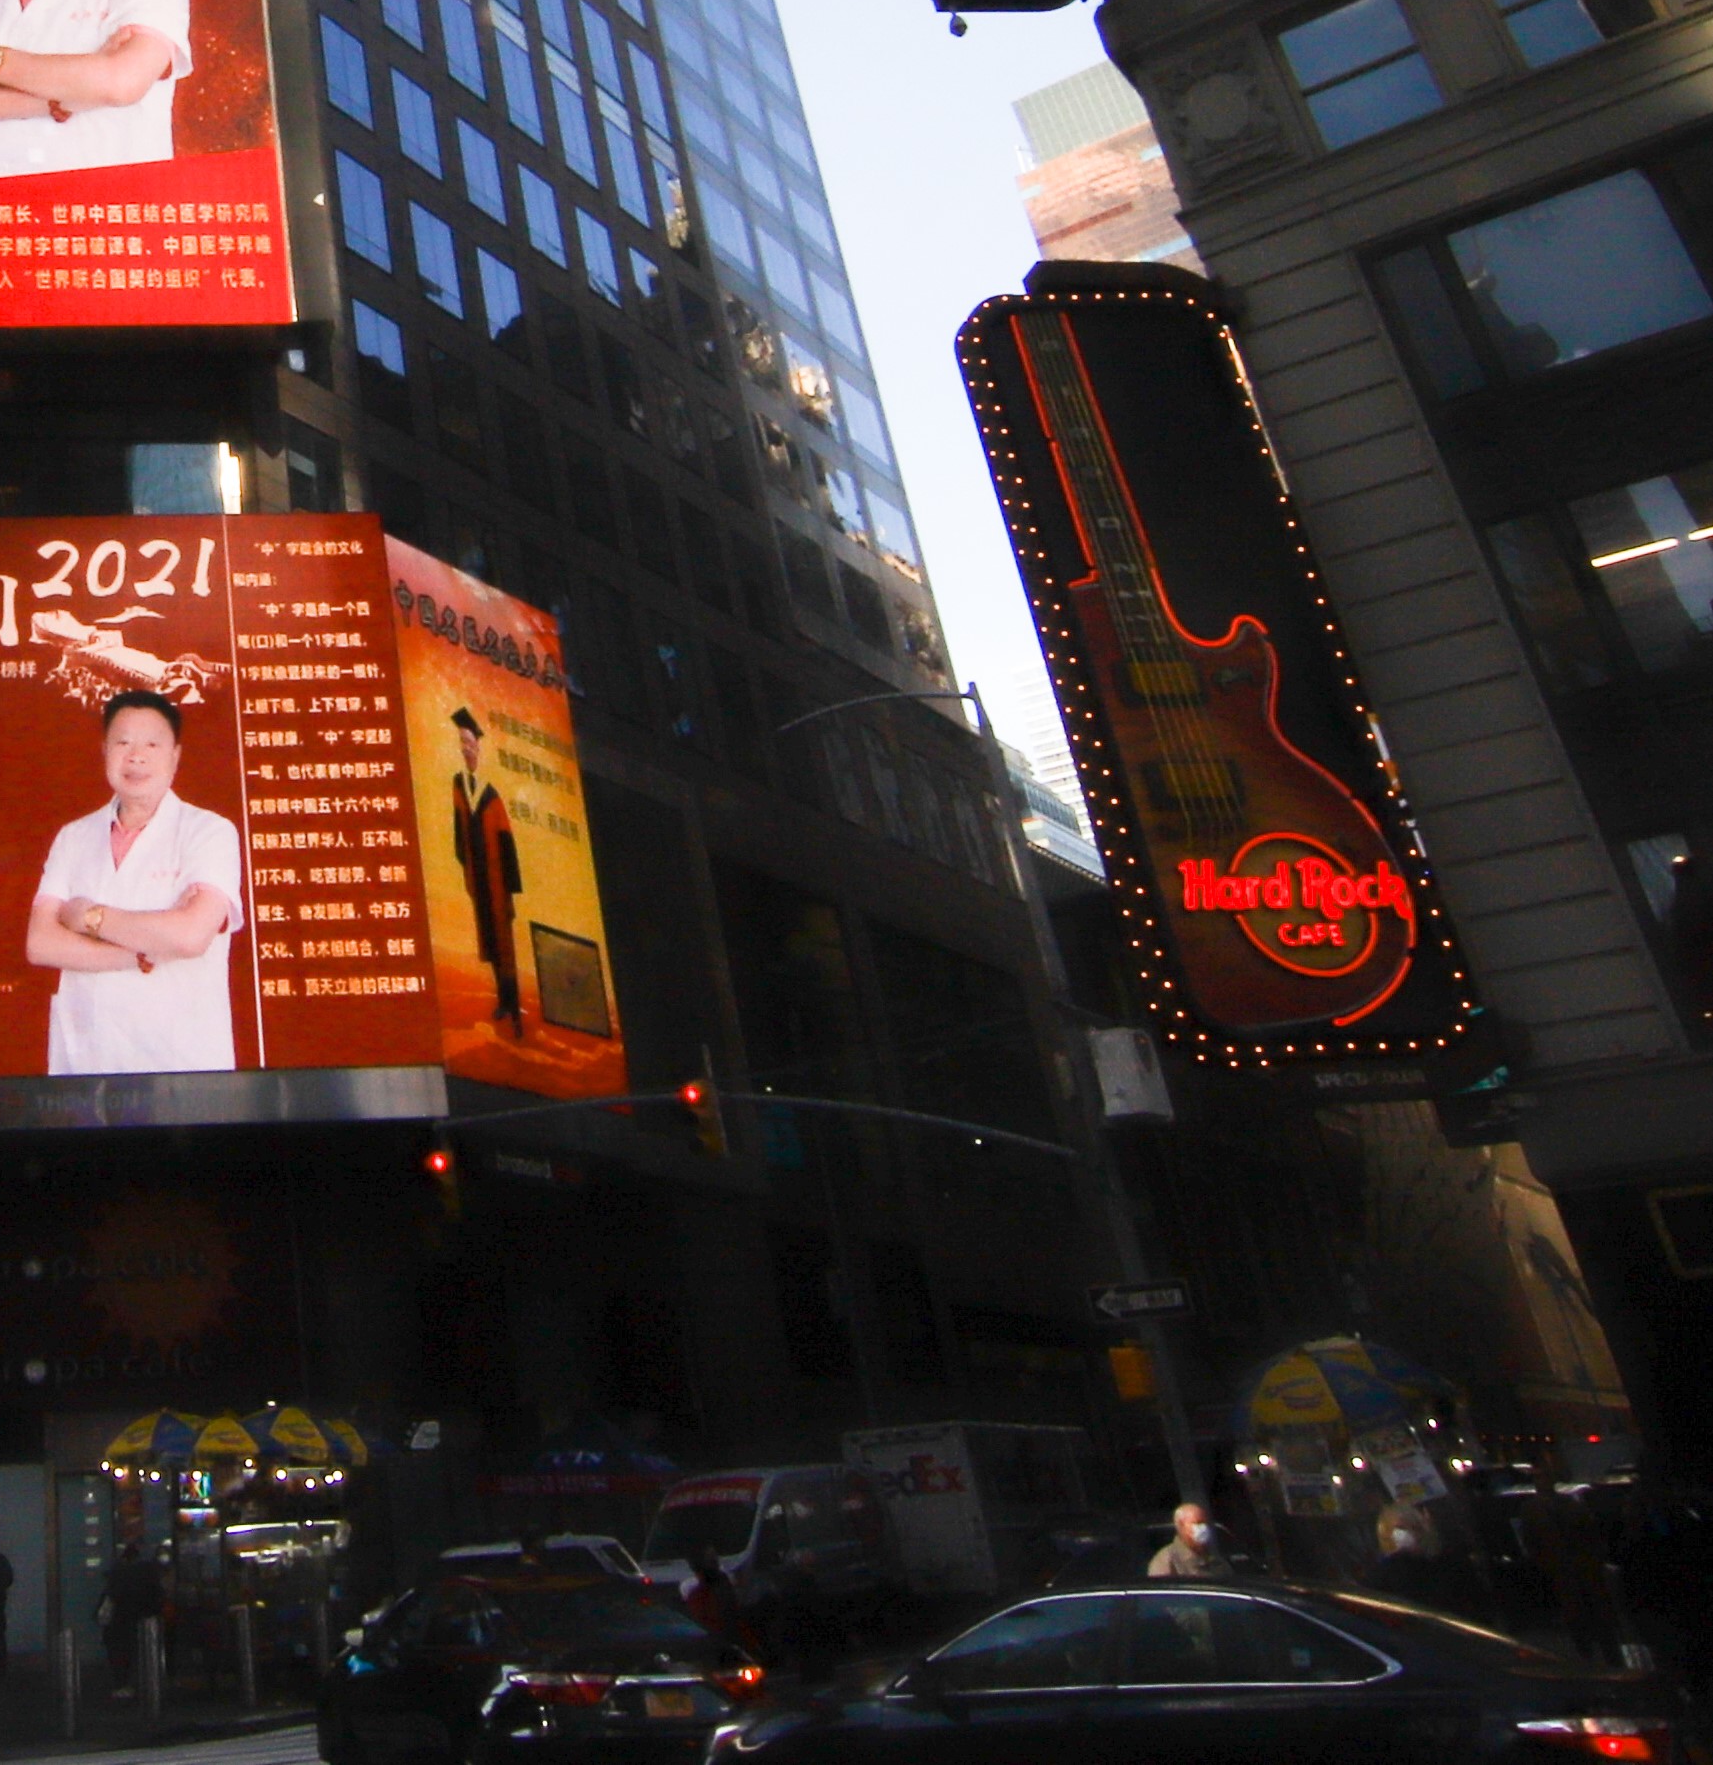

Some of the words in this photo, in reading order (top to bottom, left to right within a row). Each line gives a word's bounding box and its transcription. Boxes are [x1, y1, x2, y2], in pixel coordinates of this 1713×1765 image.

[30, 538, 216, 599] 2021
[1177, 858, 1293, 911] Hard
[1294, 856, 1414, 920] Rock
[1277, 922, 1347, 947] CAFE
[874, 1454, 966, 1497] edEx
